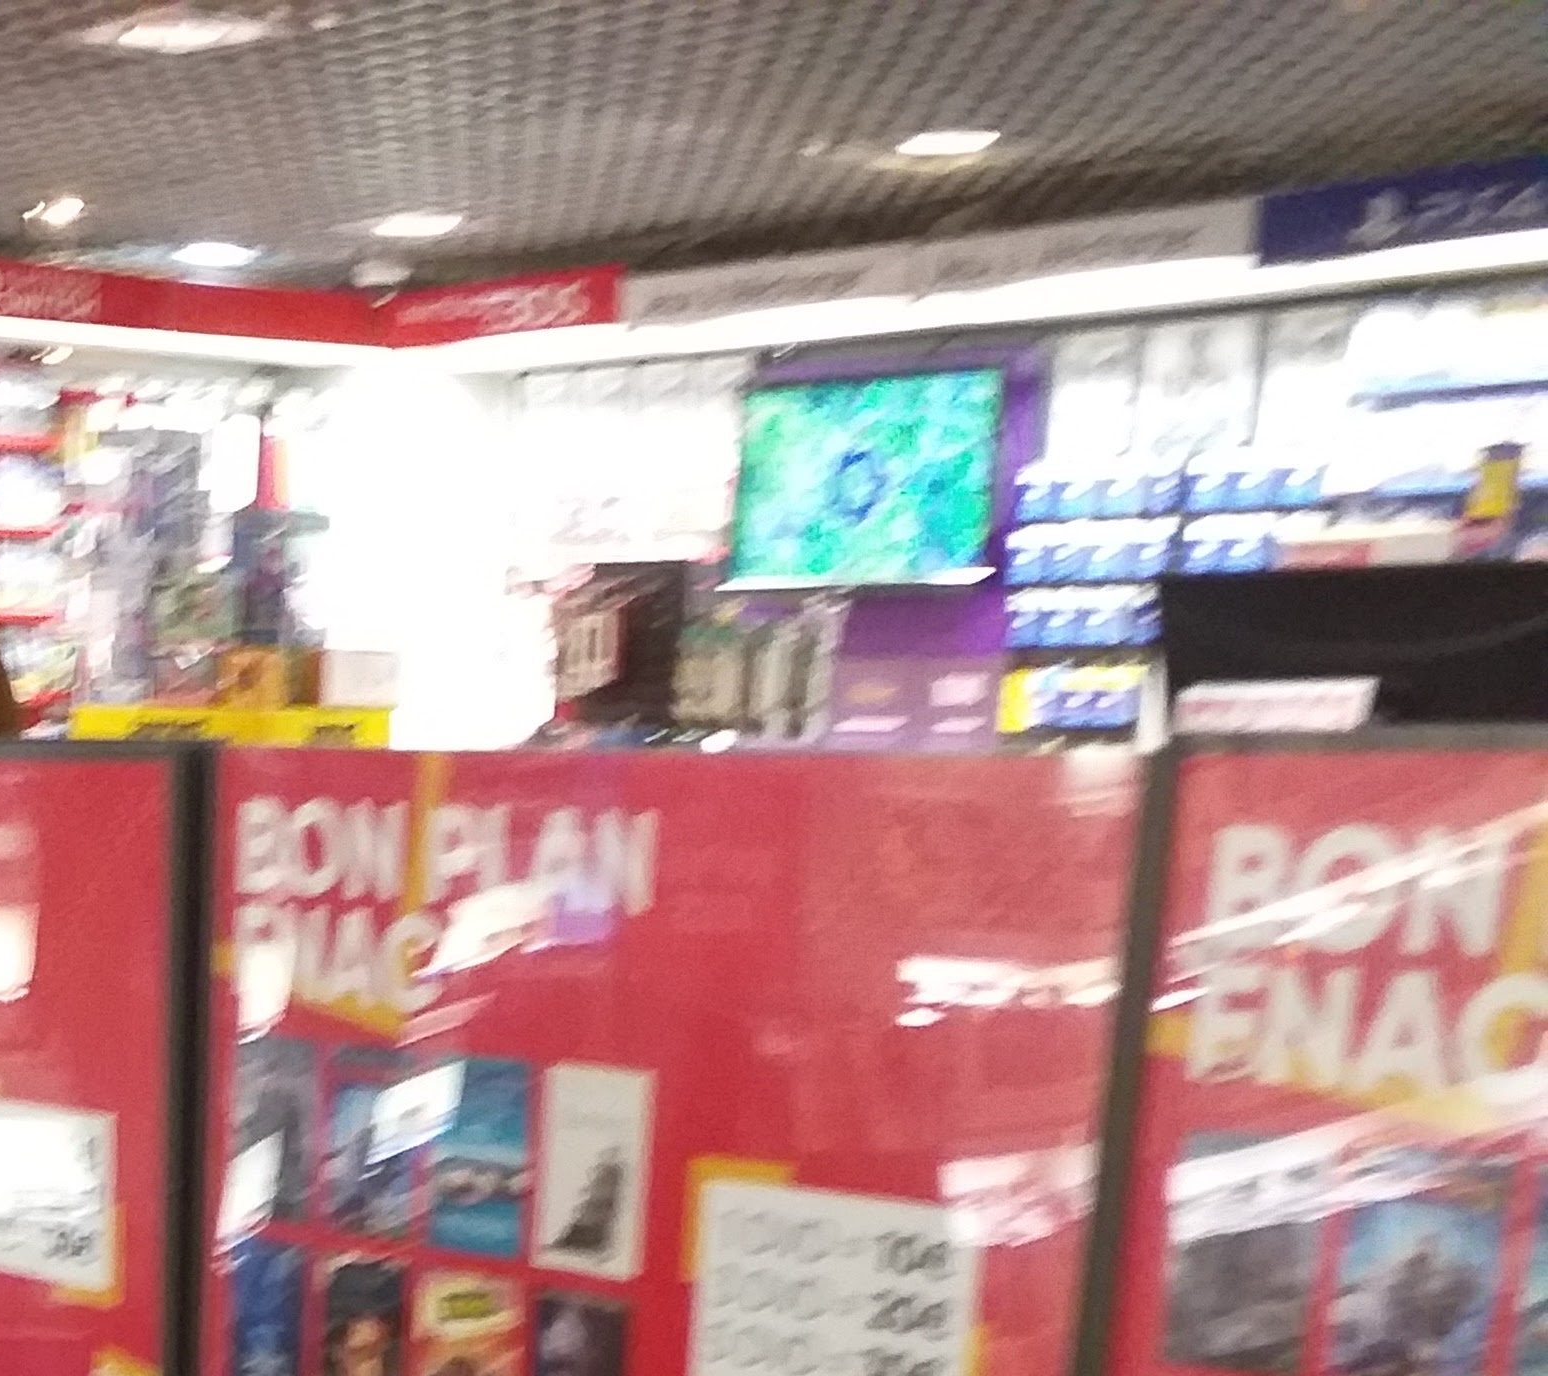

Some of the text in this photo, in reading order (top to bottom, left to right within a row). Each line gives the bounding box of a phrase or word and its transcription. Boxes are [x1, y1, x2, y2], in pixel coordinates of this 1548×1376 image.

[234, 794, 662, 918] BON PLAN
[1209, 822, 1518, 958] BON
[1184, 960, 1548, 1098] FNAC
